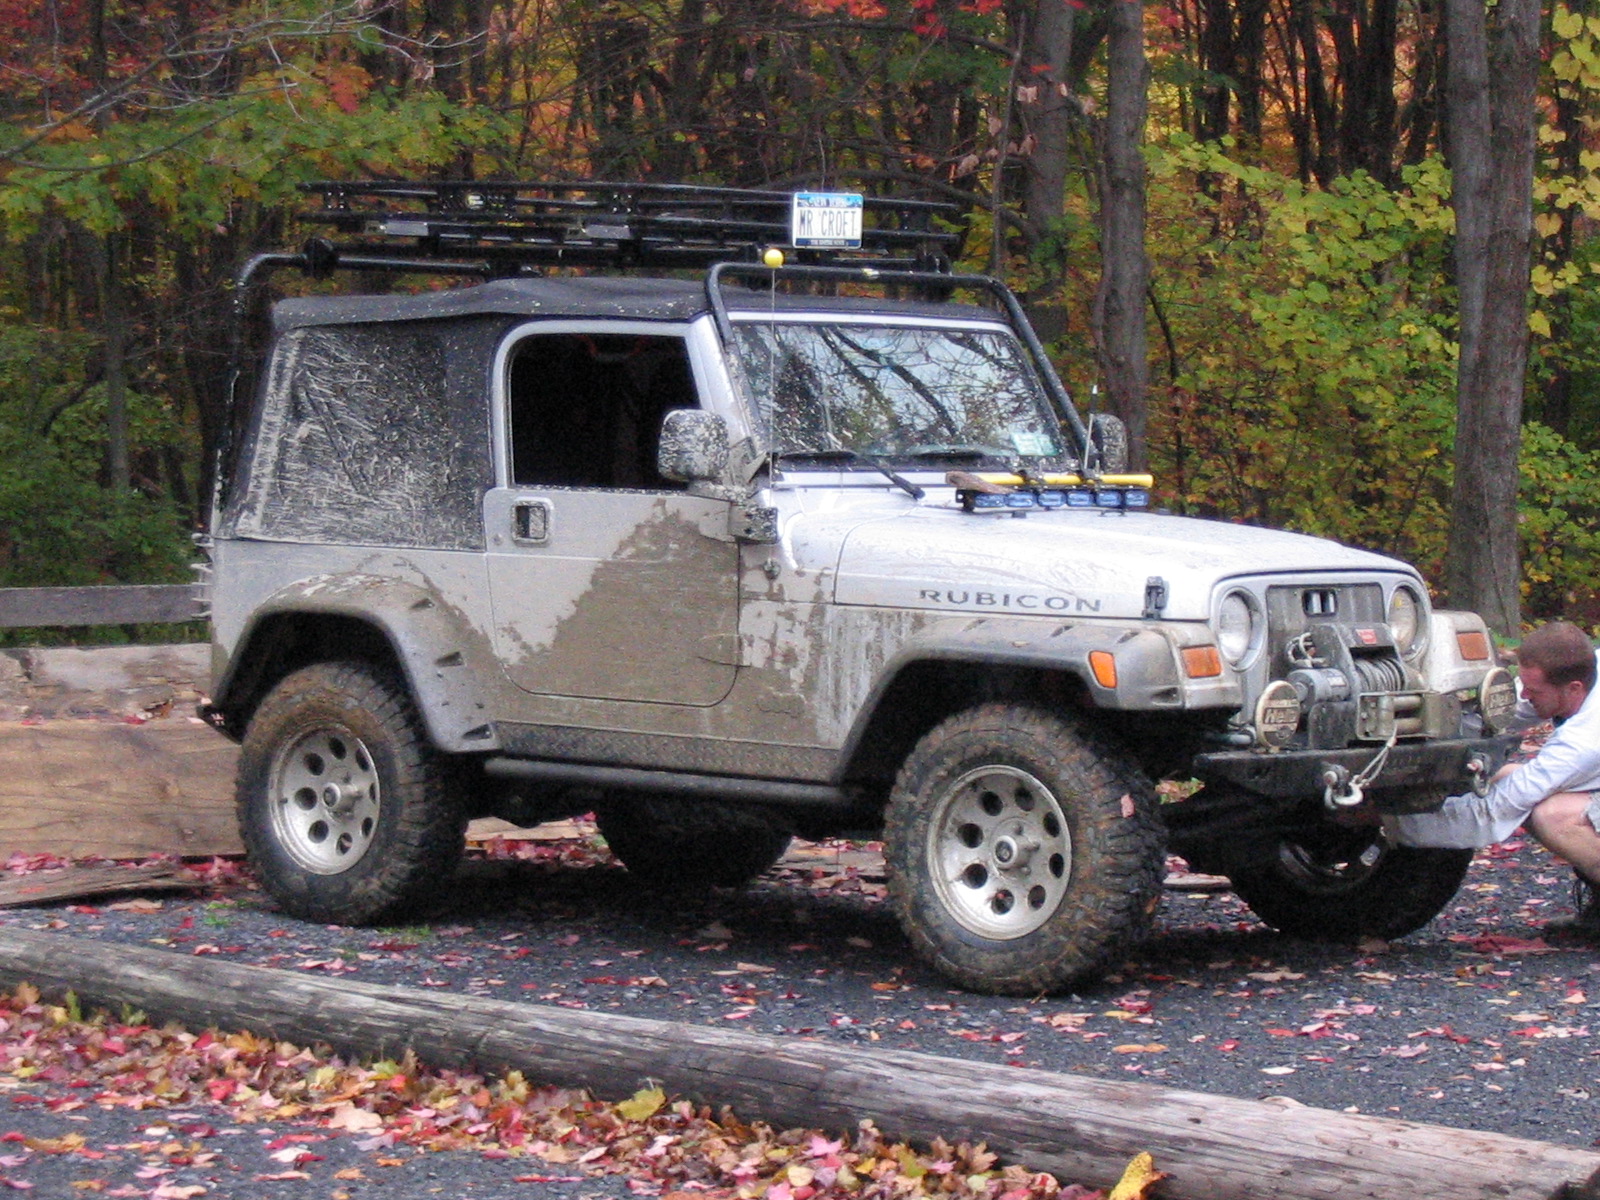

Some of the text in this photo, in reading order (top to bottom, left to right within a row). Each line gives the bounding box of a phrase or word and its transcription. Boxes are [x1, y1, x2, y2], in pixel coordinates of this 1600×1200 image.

[799, 209, 856, 236] MR CROFT
[919, 589, 1101, 612] RUBICON
